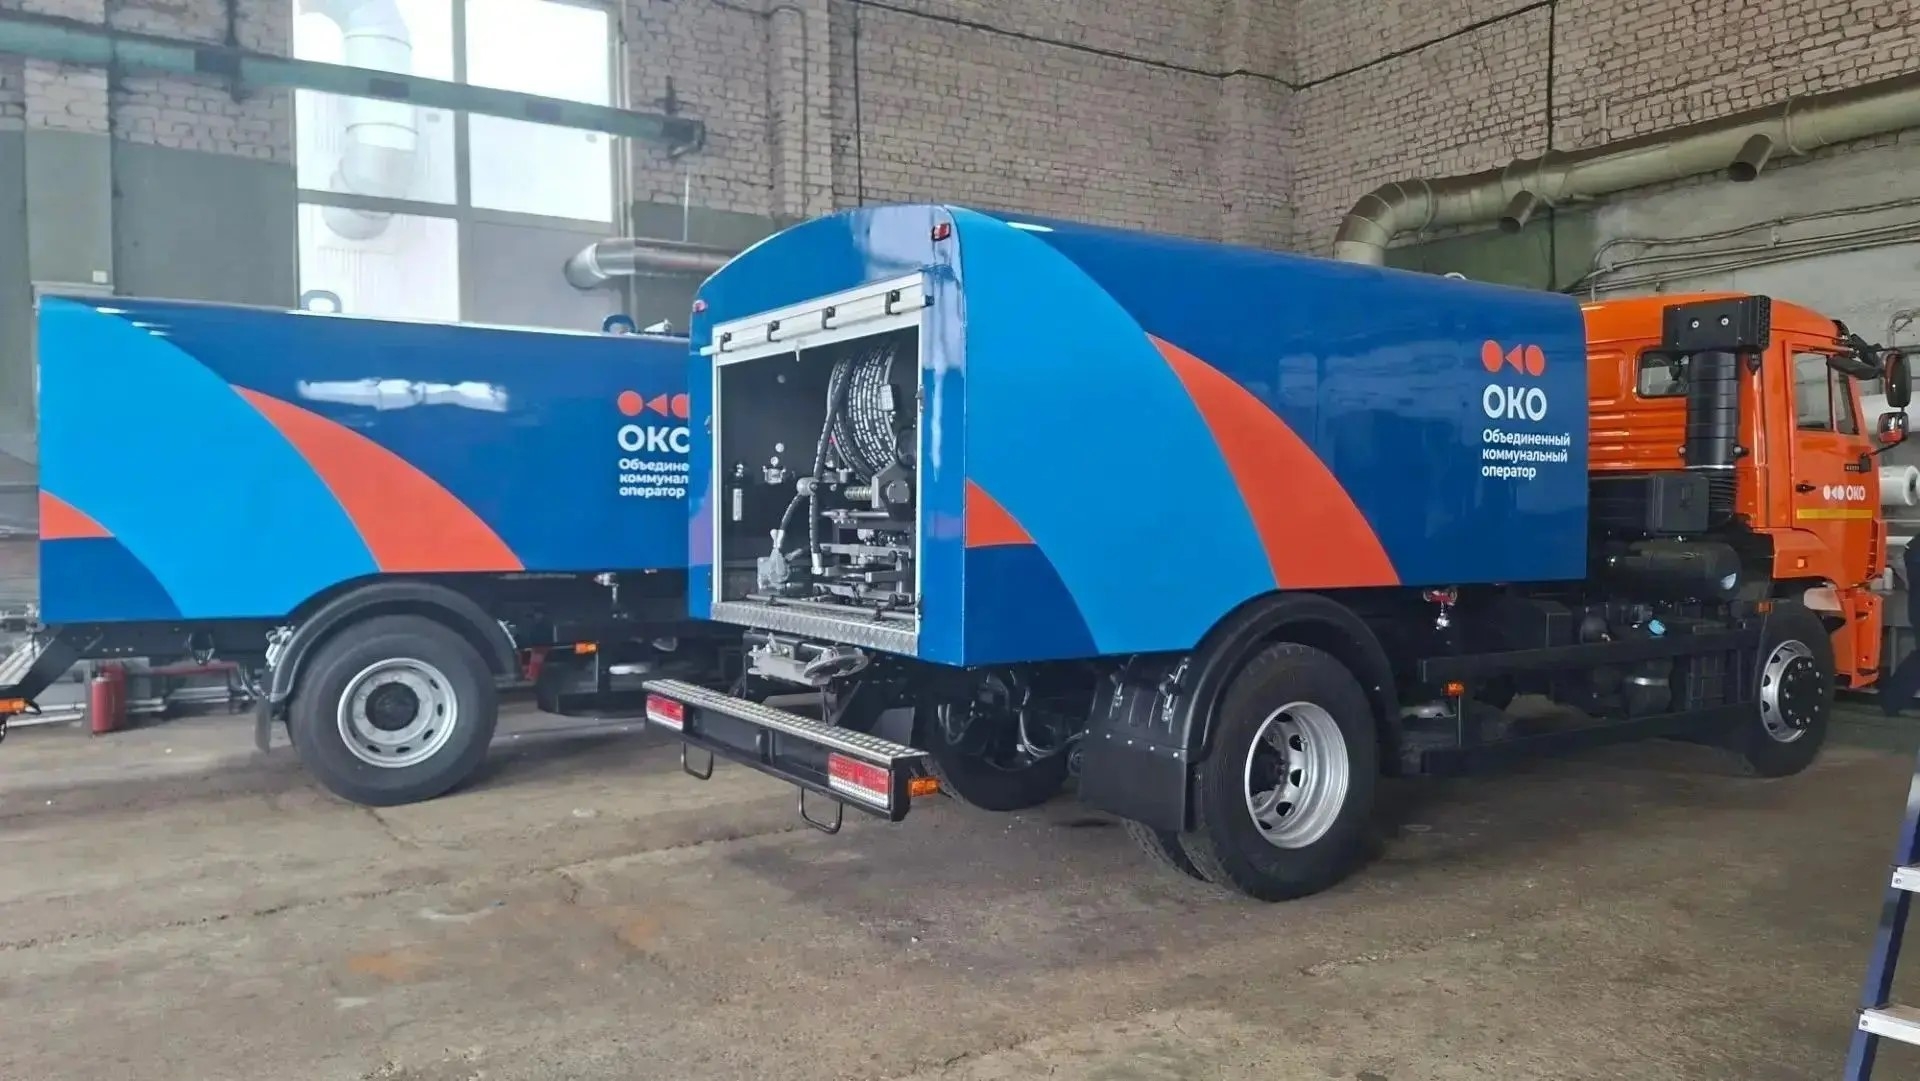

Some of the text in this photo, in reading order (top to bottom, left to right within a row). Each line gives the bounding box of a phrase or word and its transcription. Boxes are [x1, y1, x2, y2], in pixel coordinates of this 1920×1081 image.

[1483, 384, 1547, 421] ОКО
[1482, 428, 1571, 446] Объединенный
[1482, 448, 1568, 464] коммунальный
[1481, 465, 1537, 480] оператор
[619, 486, 686, 499] оператор
[1846, 485, 1866, 501] ОКО
